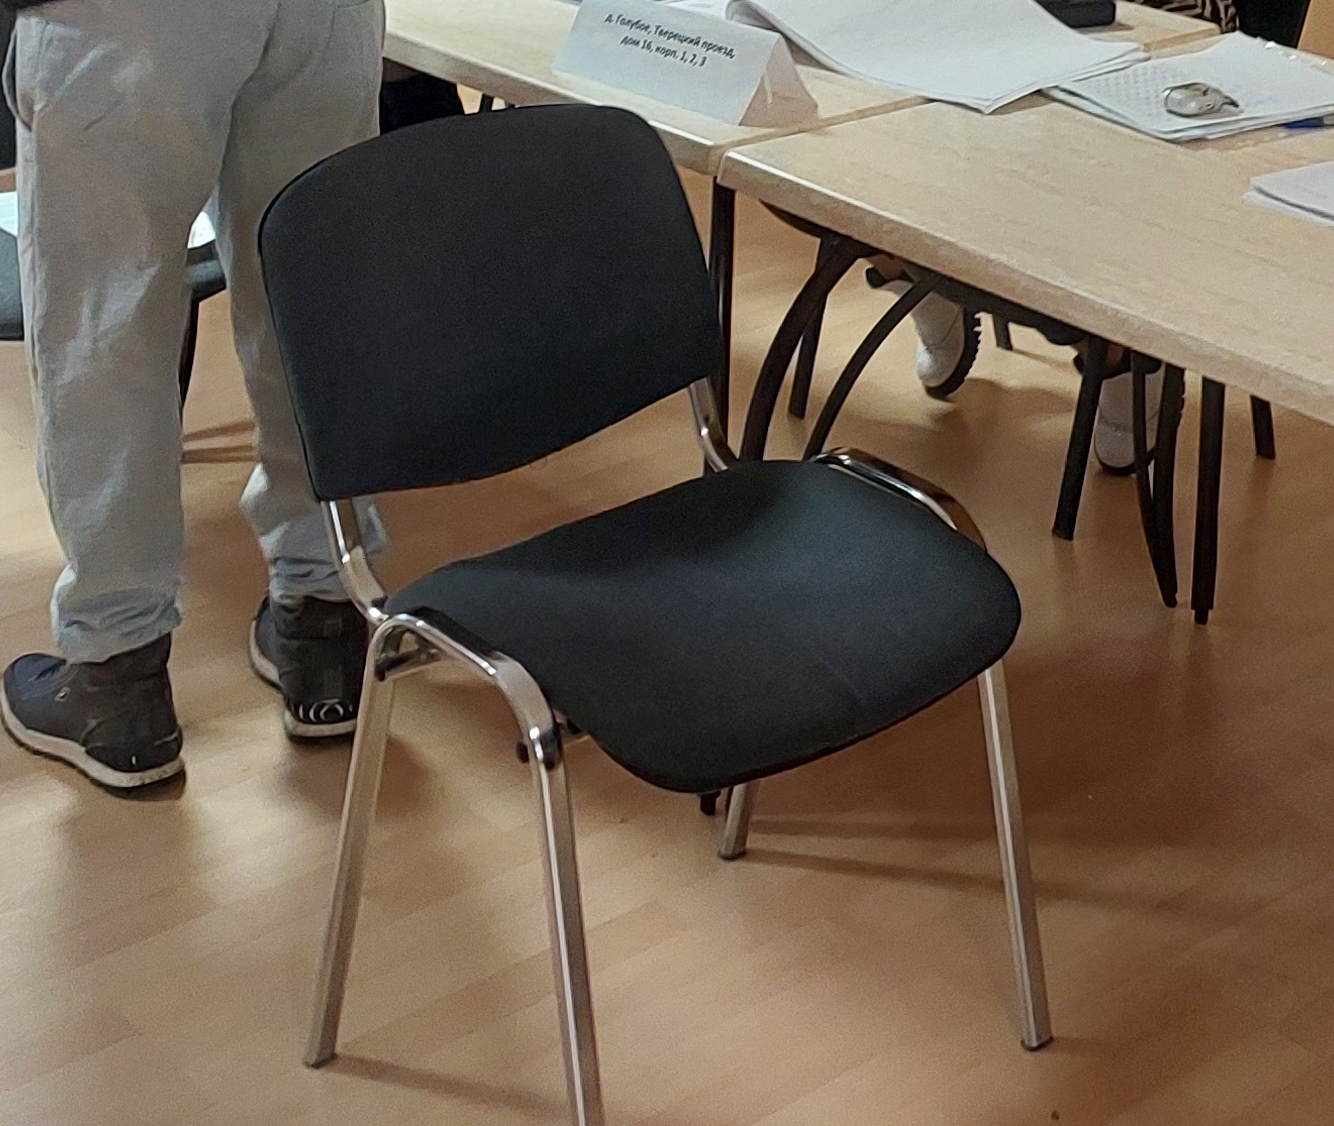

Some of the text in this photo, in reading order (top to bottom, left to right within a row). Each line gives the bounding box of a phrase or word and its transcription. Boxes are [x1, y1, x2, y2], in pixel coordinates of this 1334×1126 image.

[615, 14, 652, 35] Голубое,
[701, 41, 736, 59] проезд,
[620, 35, 639, 47] дом
[641, 39, 653, 53] 16,
[655, 45, 678, 59] корп.
[699, 56, 707, 67] 3
